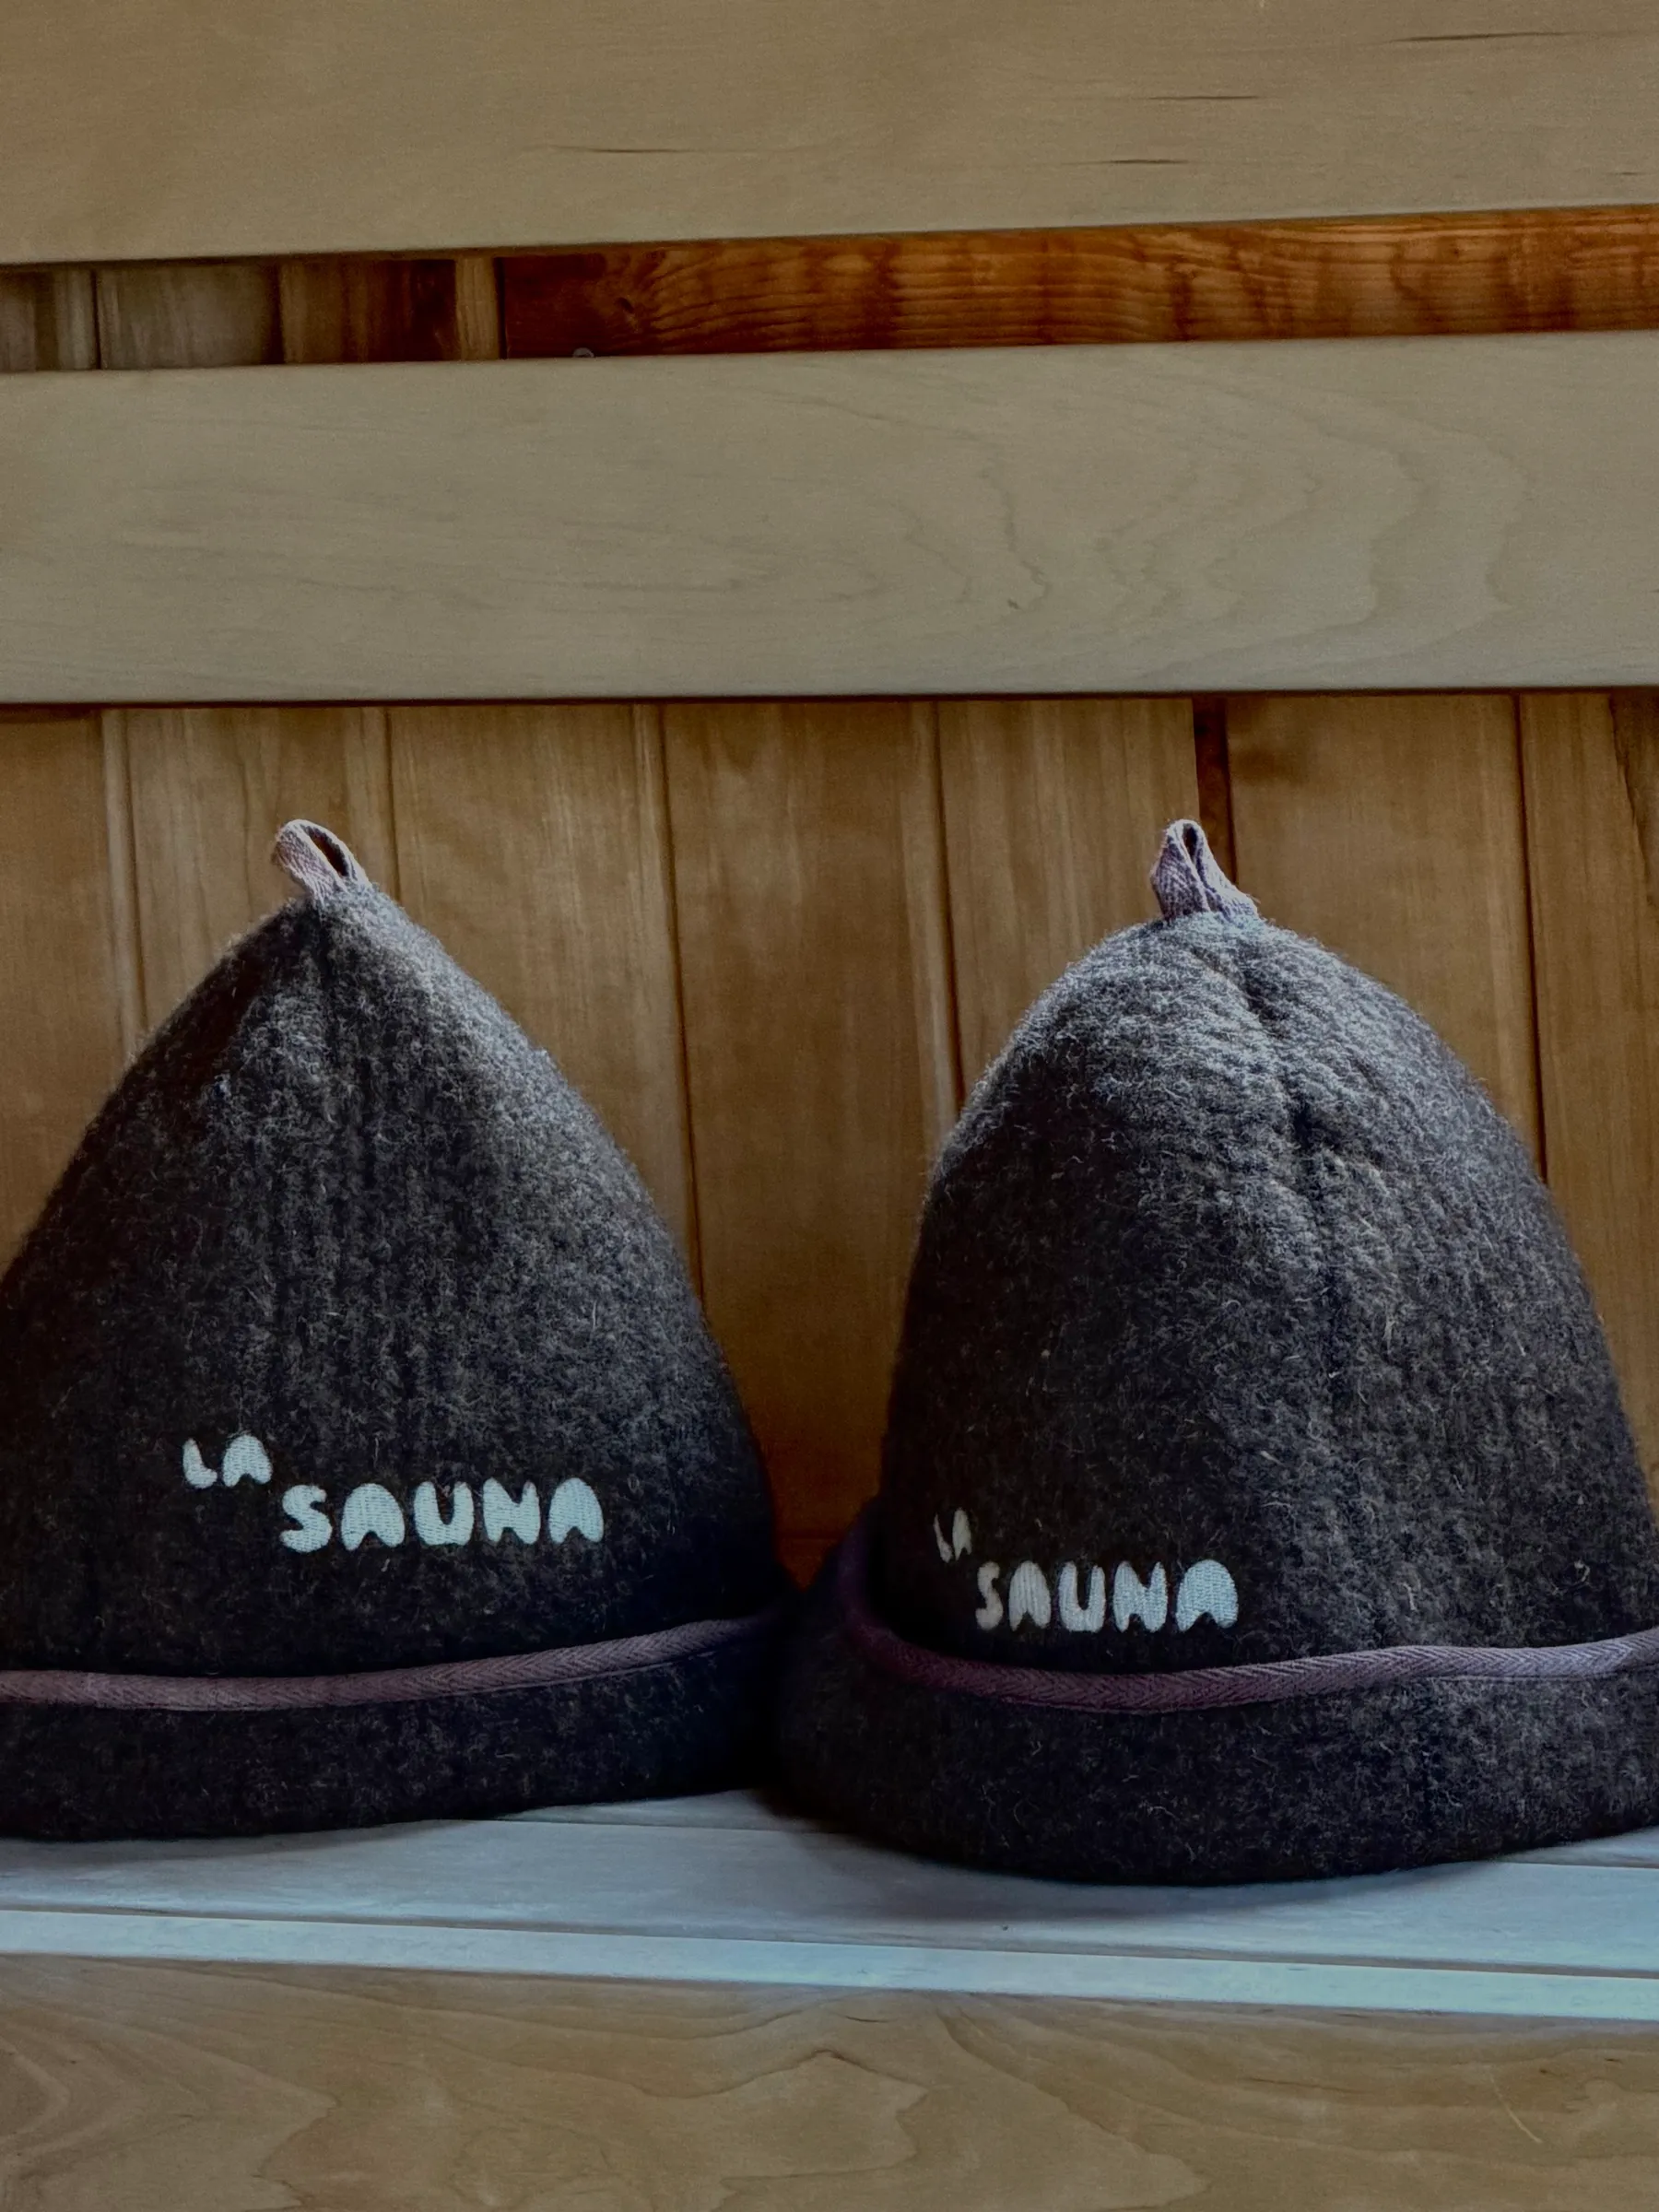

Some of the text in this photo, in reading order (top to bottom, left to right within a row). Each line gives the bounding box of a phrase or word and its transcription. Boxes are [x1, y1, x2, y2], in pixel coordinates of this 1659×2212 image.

[183, 1434, 273, 1488] LA
[280, 1477, 605, 1553] SAUNA
[933, 1507, 972, 1563] LA
[975, 1559, 1239, 1632] SAUNA
